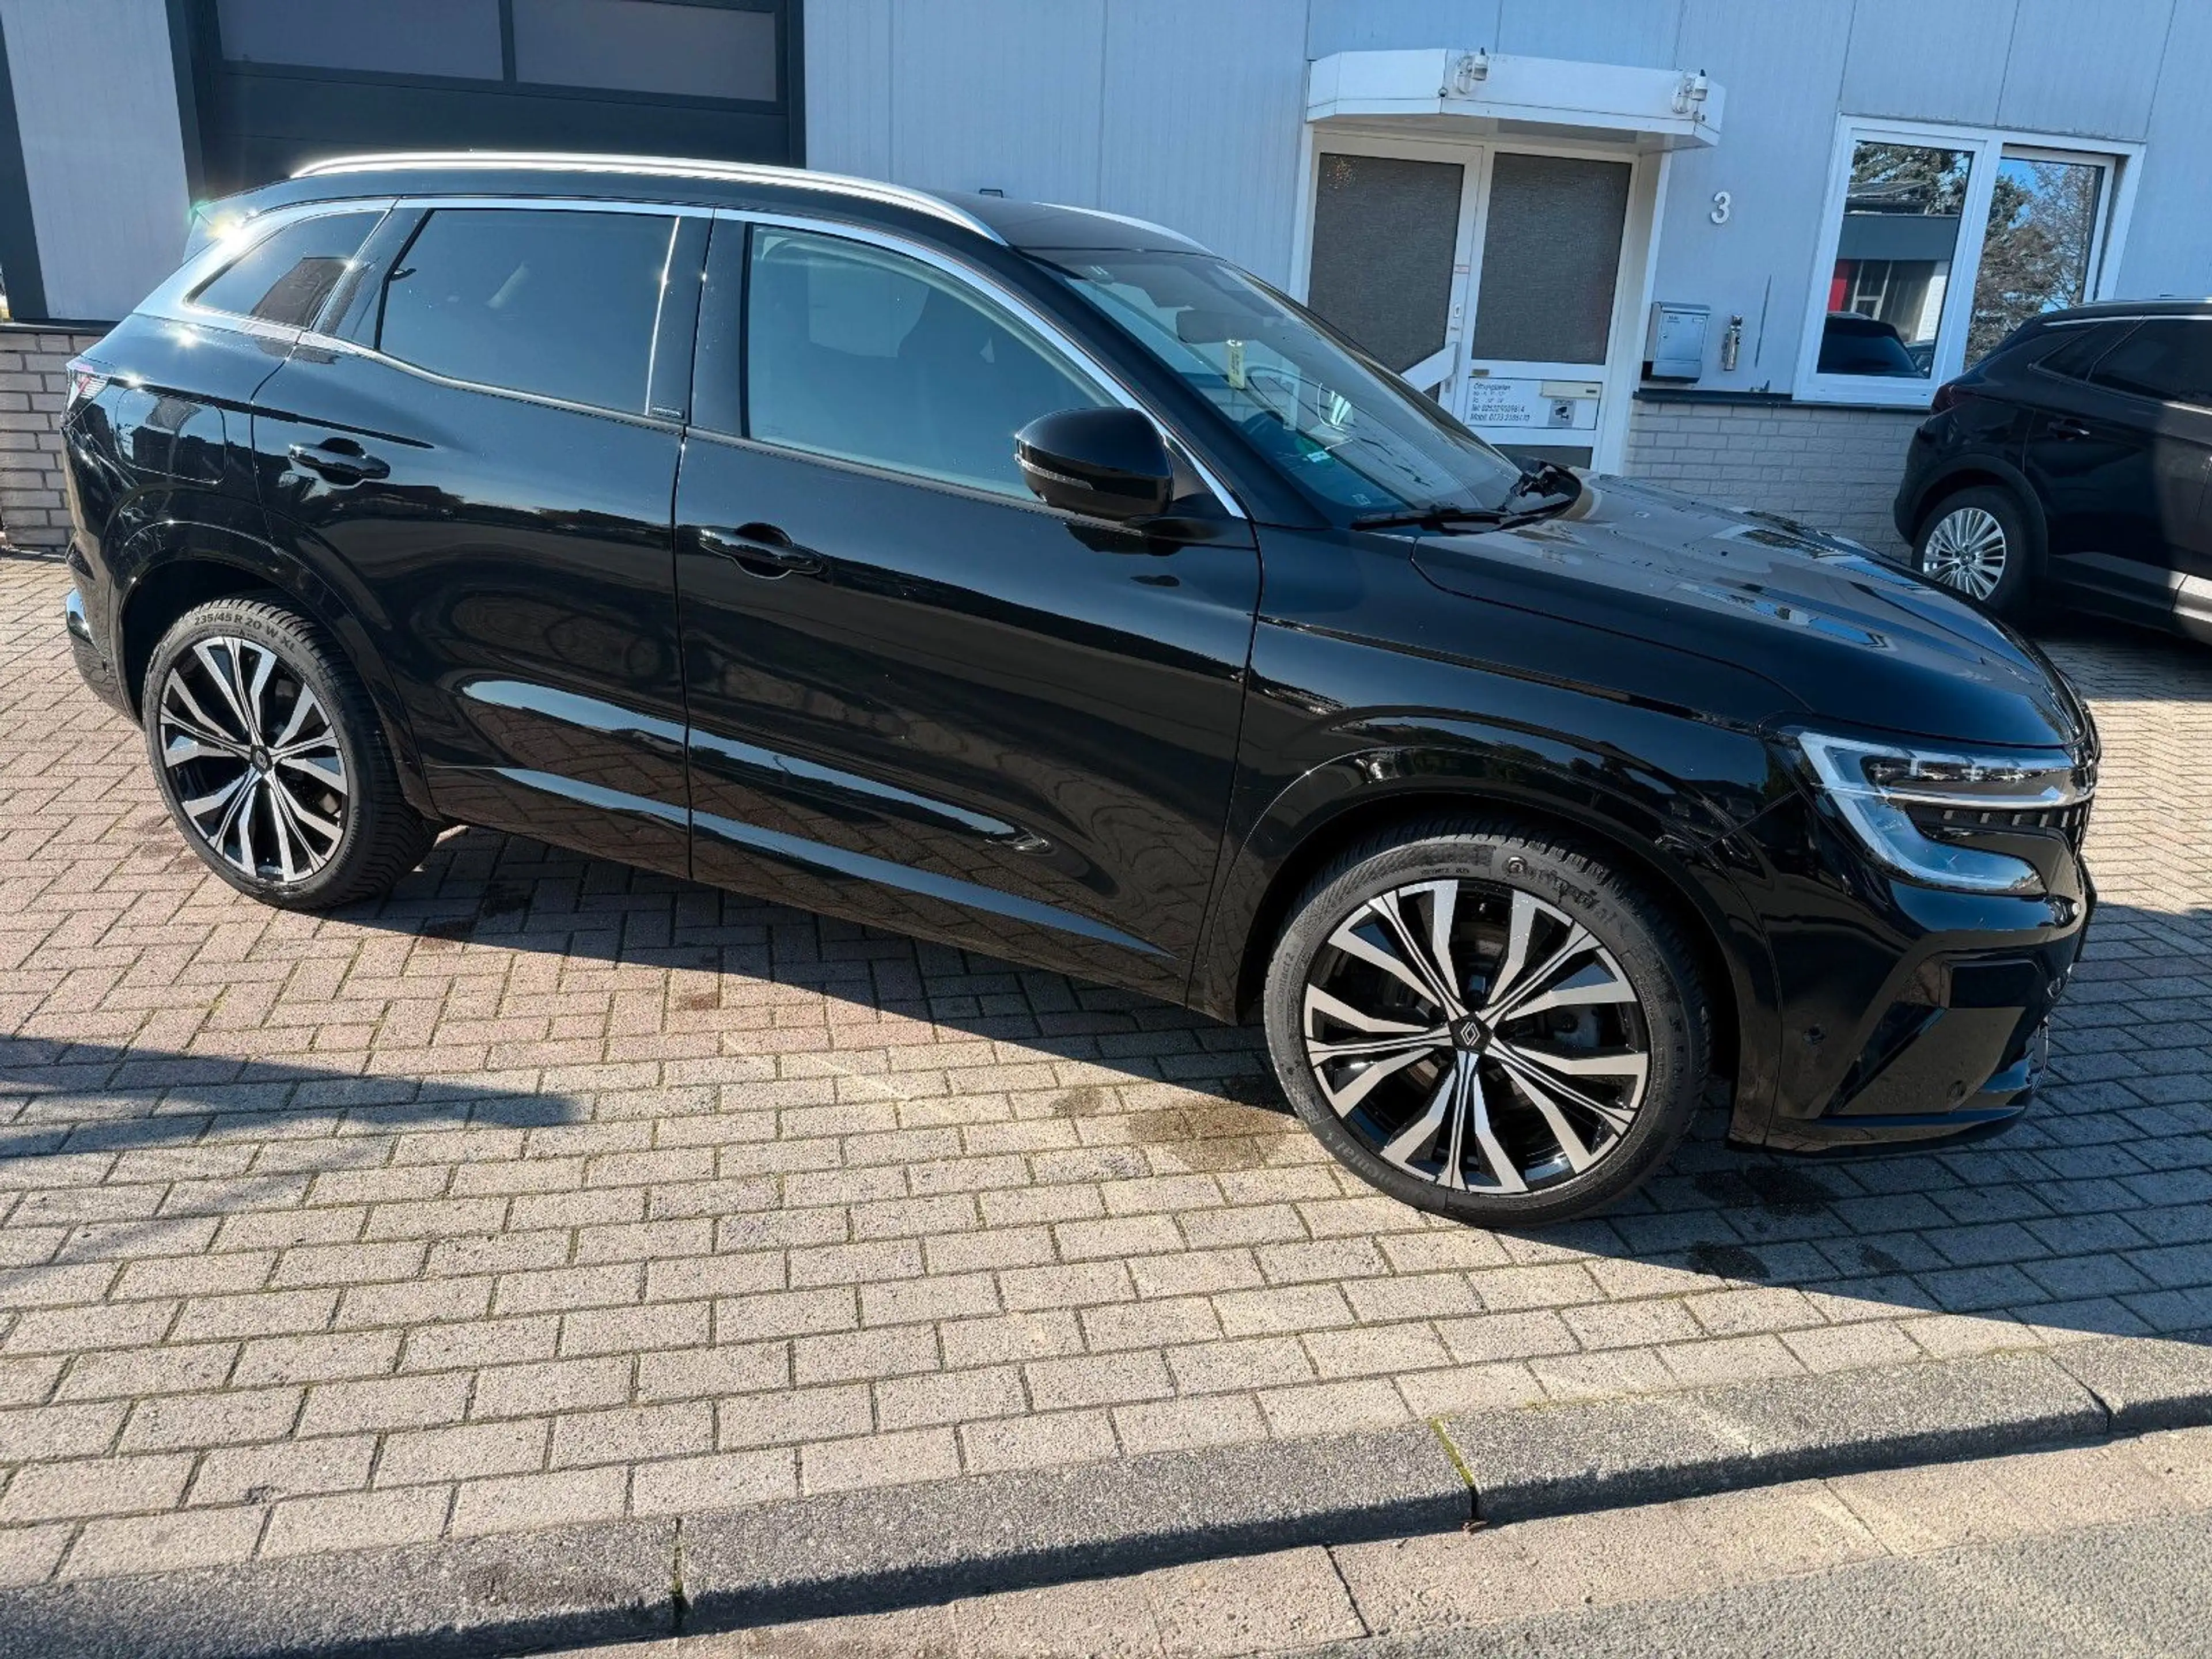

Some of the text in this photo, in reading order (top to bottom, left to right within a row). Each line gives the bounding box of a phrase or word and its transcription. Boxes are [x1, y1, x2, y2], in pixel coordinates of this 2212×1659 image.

[1710, 191, 1731, 225] 3
[194, 612, 232, 626] 235/45
[234, 614, 243, 624] R
[244, 618, 262, 630] 20
[266, 626, 279, 638] W
[280, 635, 296, 654] XL
